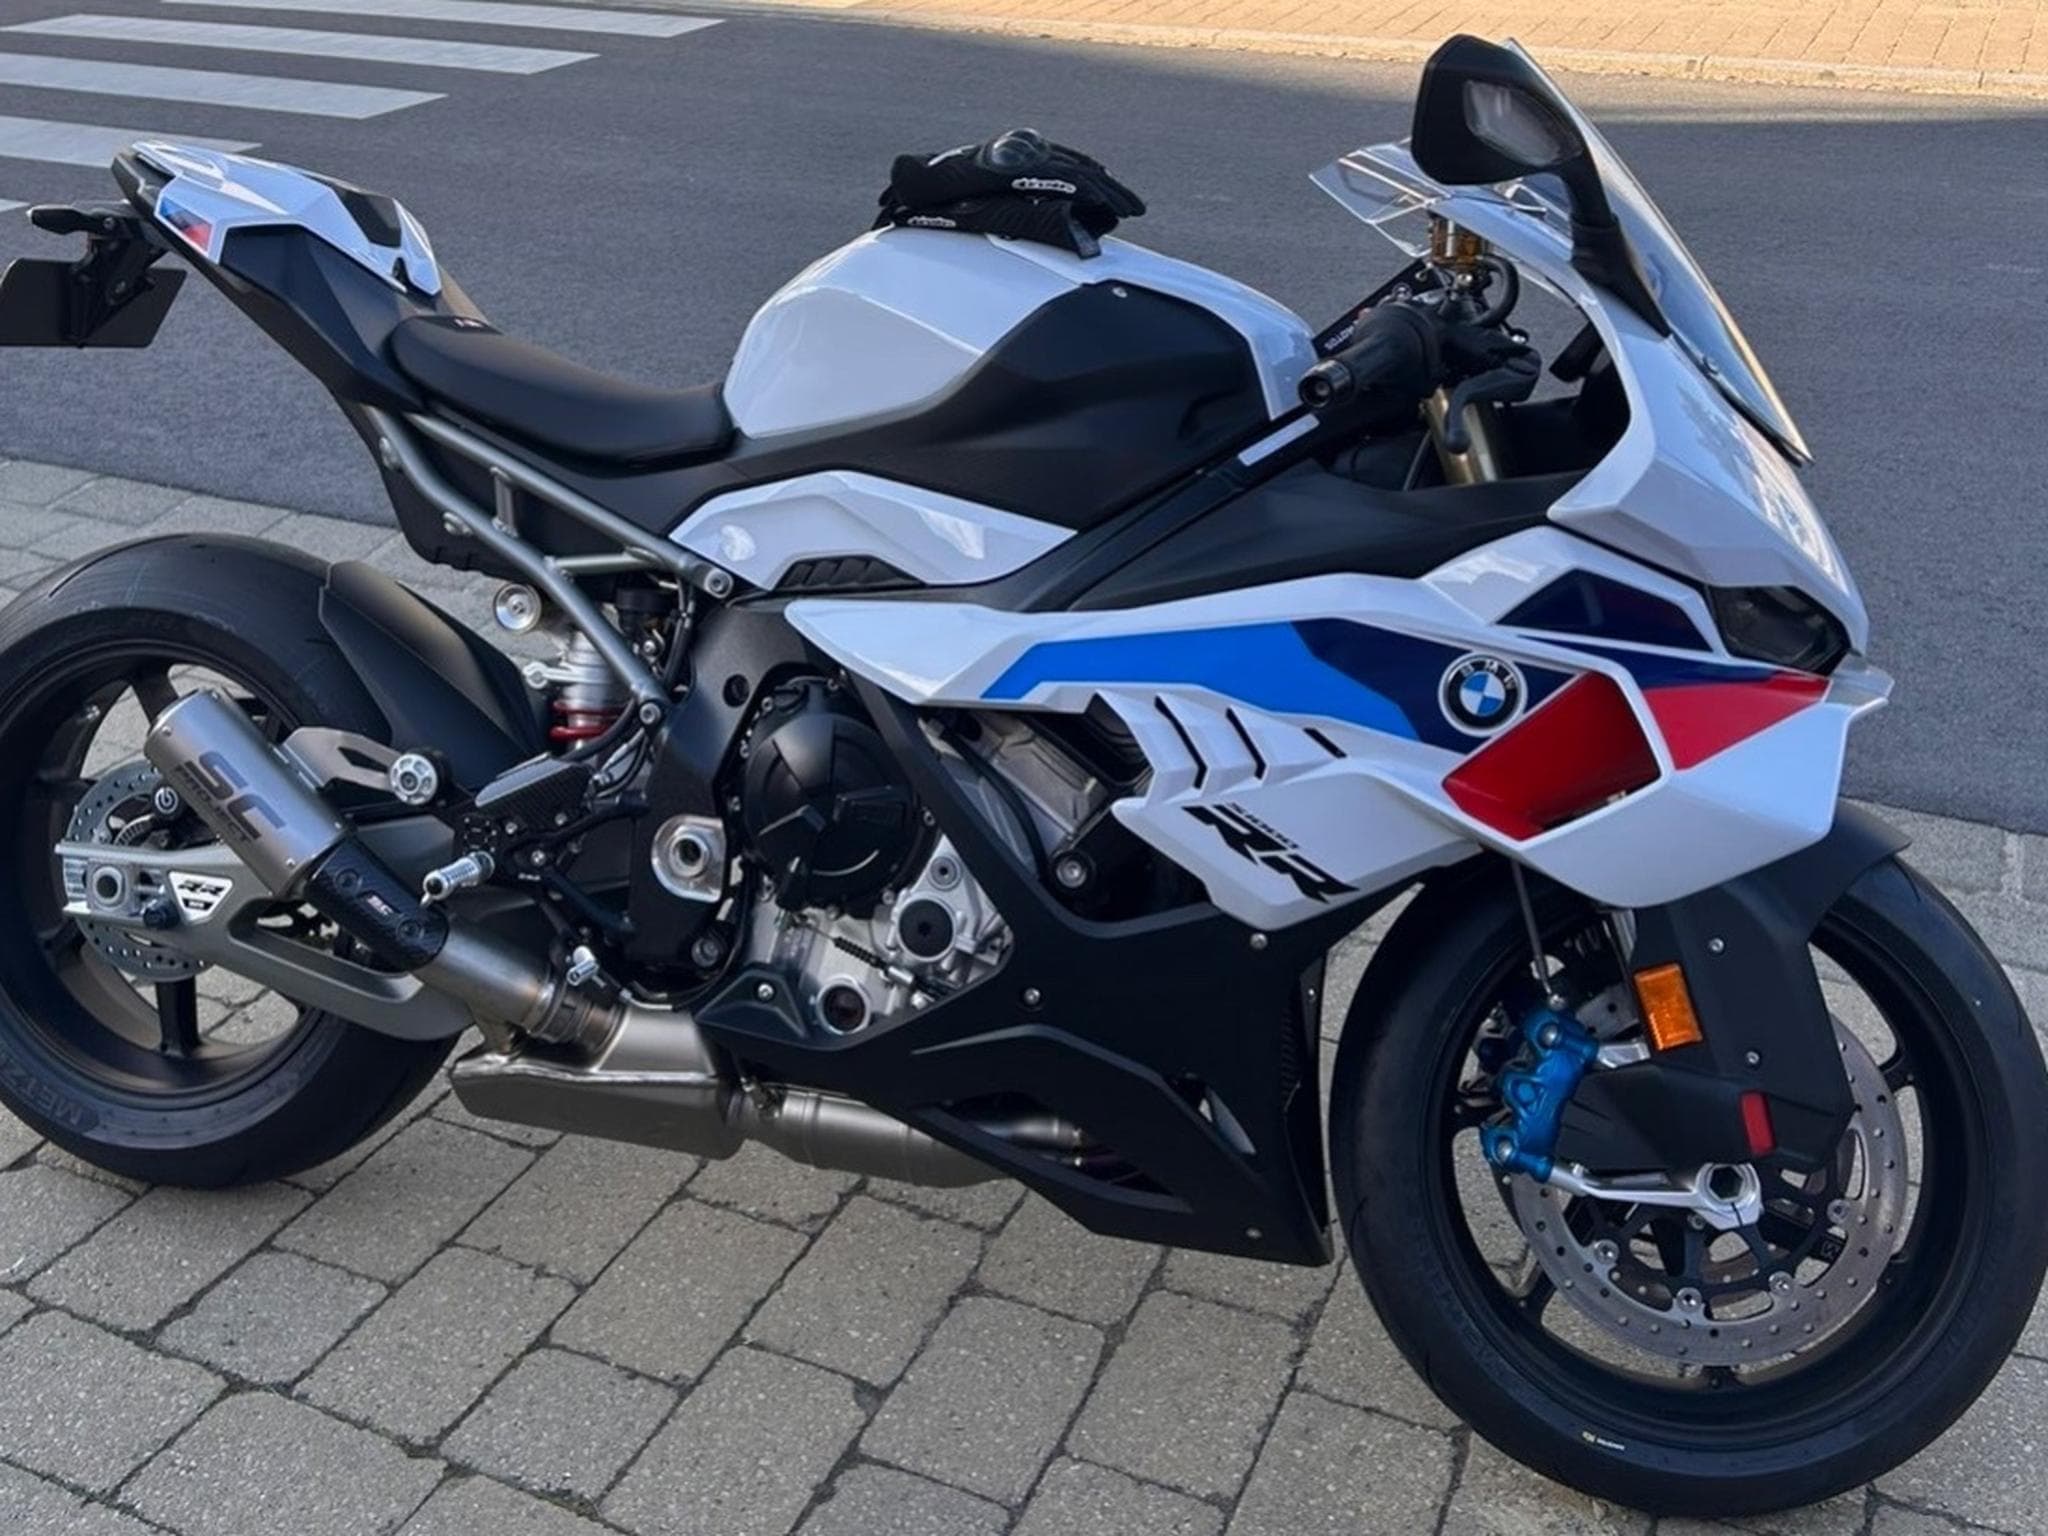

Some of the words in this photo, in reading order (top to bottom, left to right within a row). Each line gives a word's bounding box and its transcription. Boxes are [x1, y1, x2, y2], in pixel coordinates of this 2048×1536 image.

[1460, 659, 1517, 690] BMW
[183, 751, 286, 839] SC
[1181, 805, 1360, 904] RR
